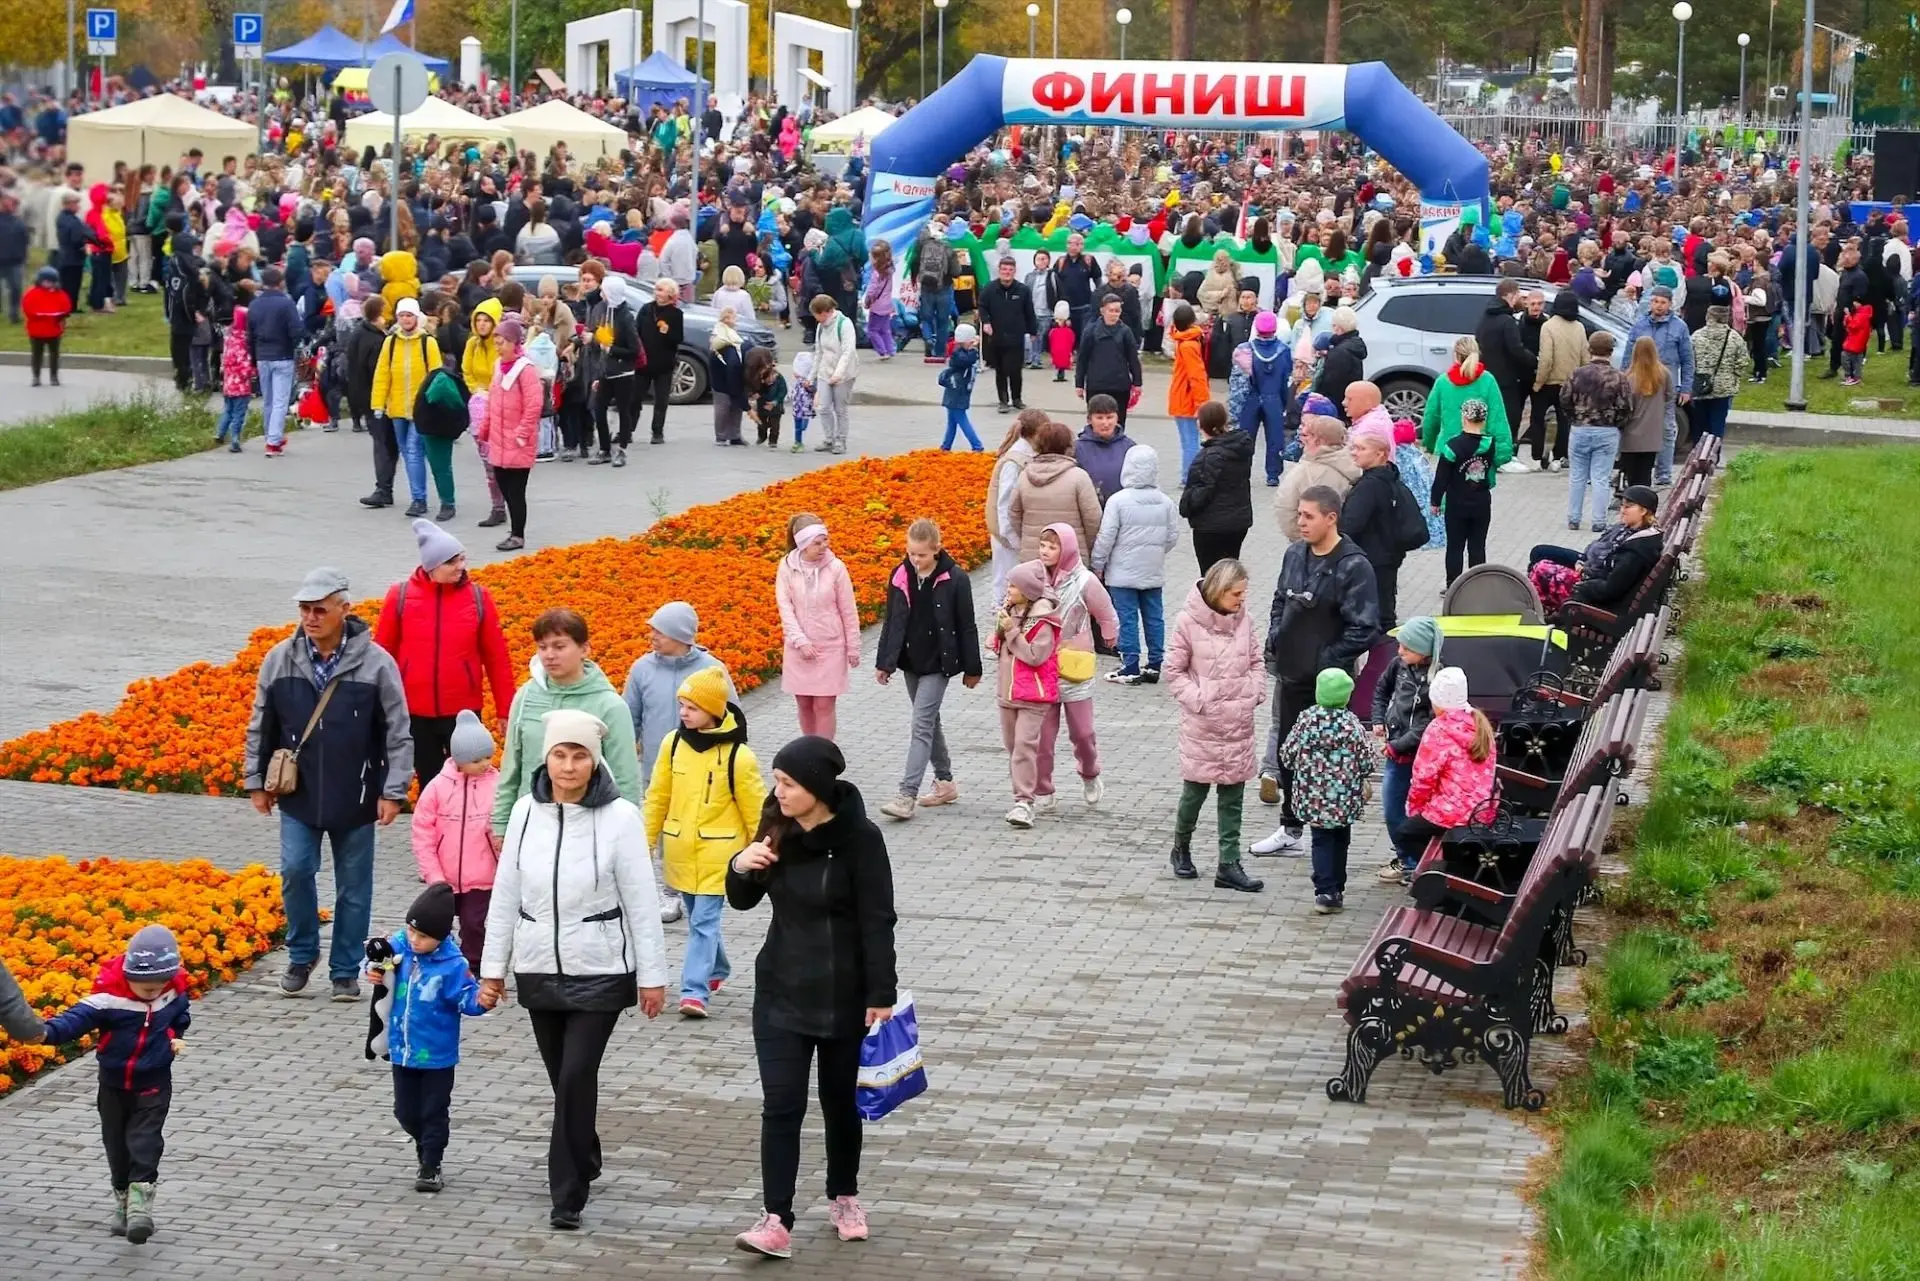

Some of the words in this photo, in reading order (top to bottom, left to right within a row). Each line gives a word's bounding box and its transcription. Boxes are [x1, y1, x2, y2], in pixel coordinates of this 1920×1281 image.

[94, 13, 111, 36] P
[240, 18, 258, 41] P
[1032, 71, 1307, 117] ФИНИШ
